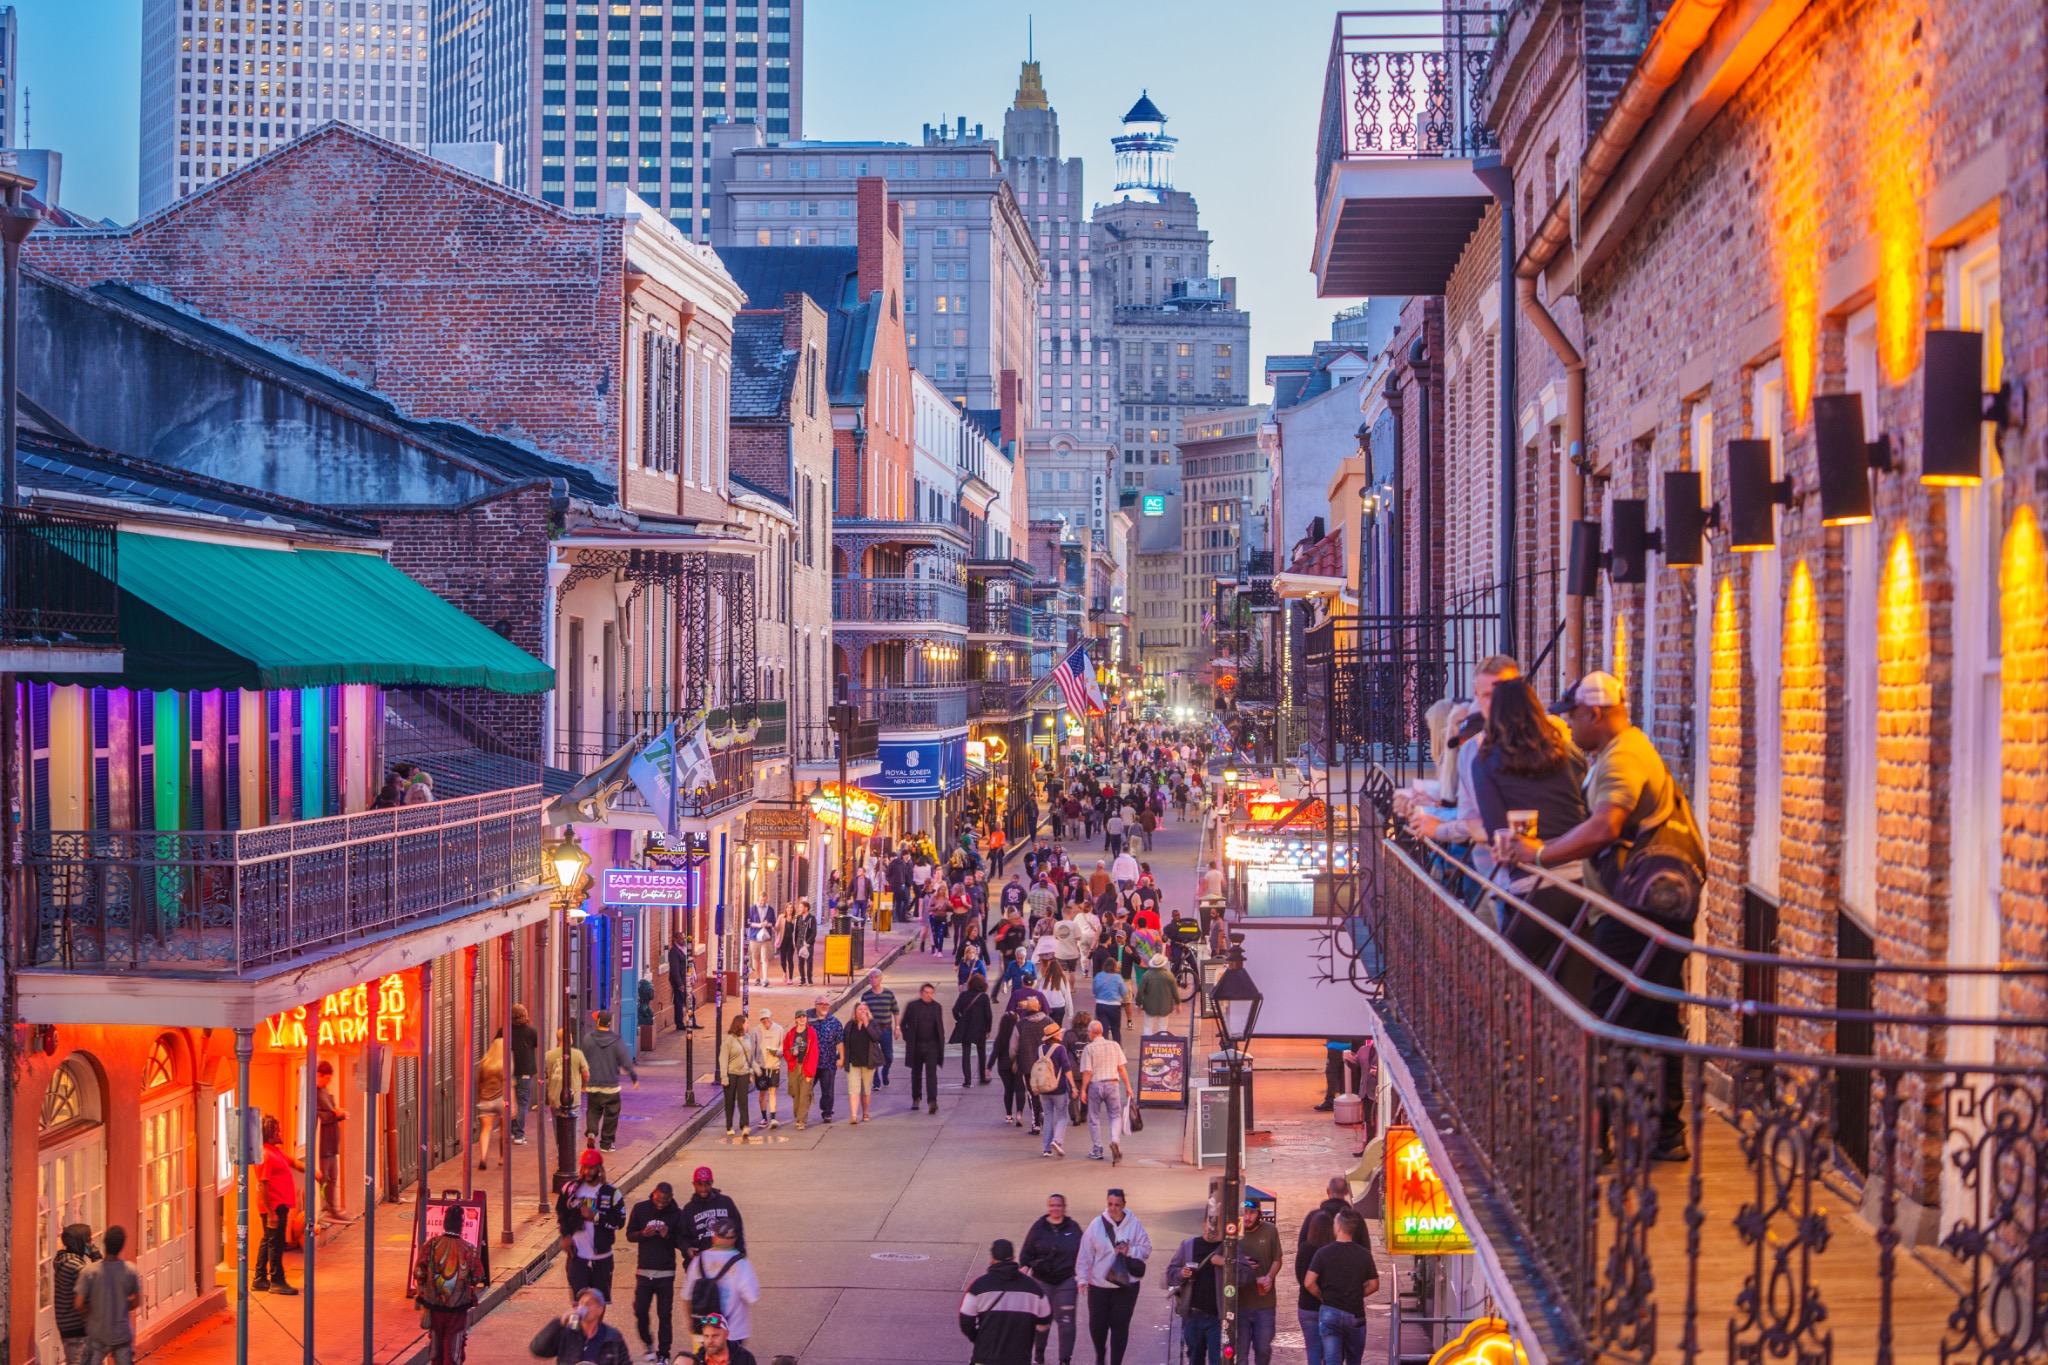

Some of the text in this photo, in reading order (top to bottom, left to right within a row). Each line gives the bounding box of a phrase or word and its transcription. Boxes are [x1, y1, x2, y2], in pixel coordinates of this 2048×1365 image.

[1094, 475, 1103, 529] ASTOR
[1146, 498, 1162, 507] AC
[609, 874, 632, 884] FAT
[293, 1016, 406, 1048] MARKET
[1144, 1047, 1182, 1056] ULTIMATE
[1404, 1216, 1456, 1232] HAND
[1397, 1234, 1417, 1243] NEW
[1417, 1234, 1456, 1243] ORLEANS
